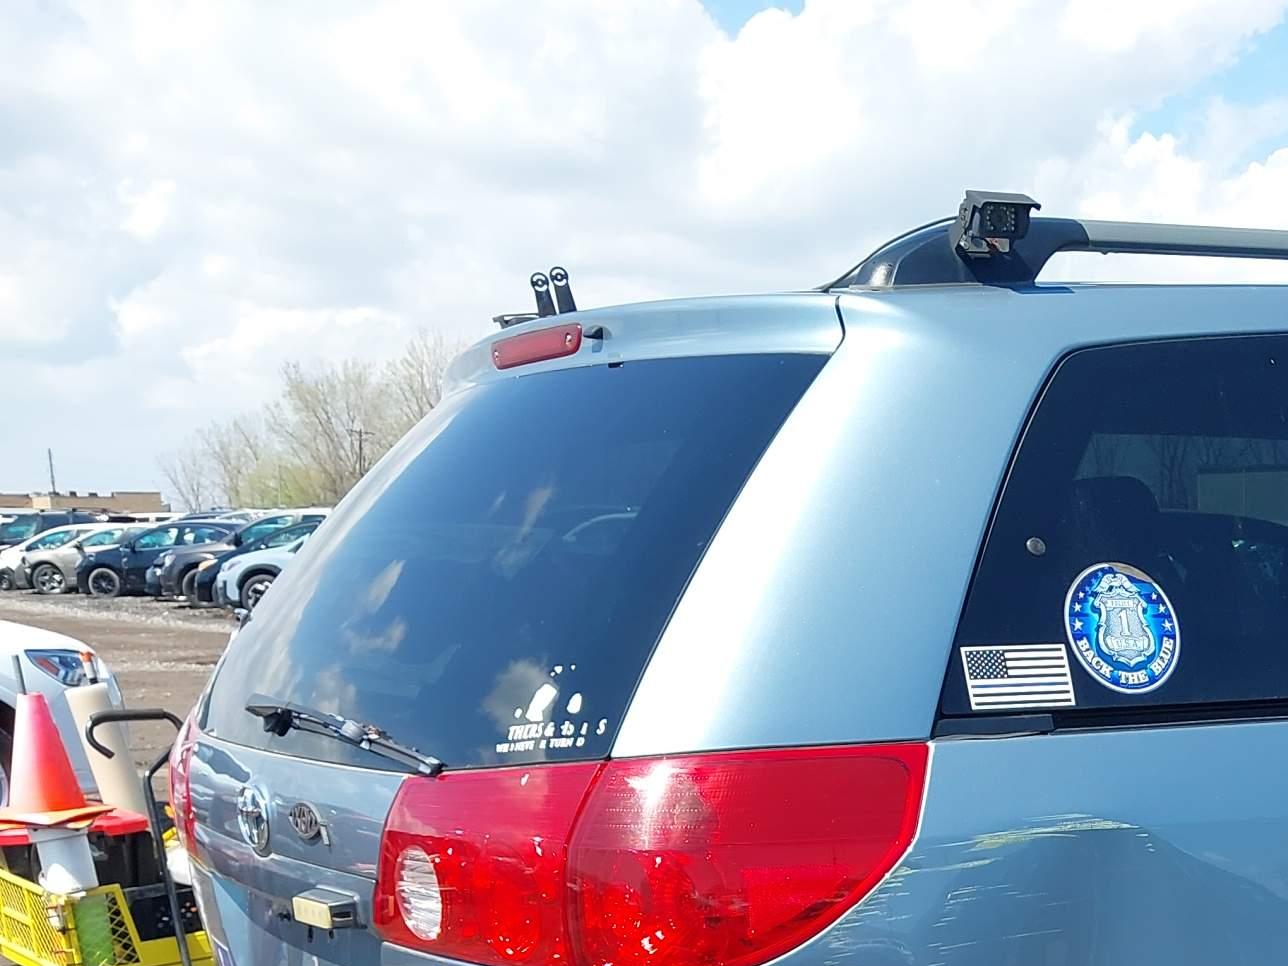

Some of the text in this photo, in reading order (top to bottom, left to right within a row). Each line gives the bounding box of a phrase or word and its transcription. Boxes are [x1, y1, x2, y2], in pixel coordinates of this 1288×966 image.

[1118, 608, 1133, 637] 1
[1076, 636, 1174, 685] BACK THE BLUE
